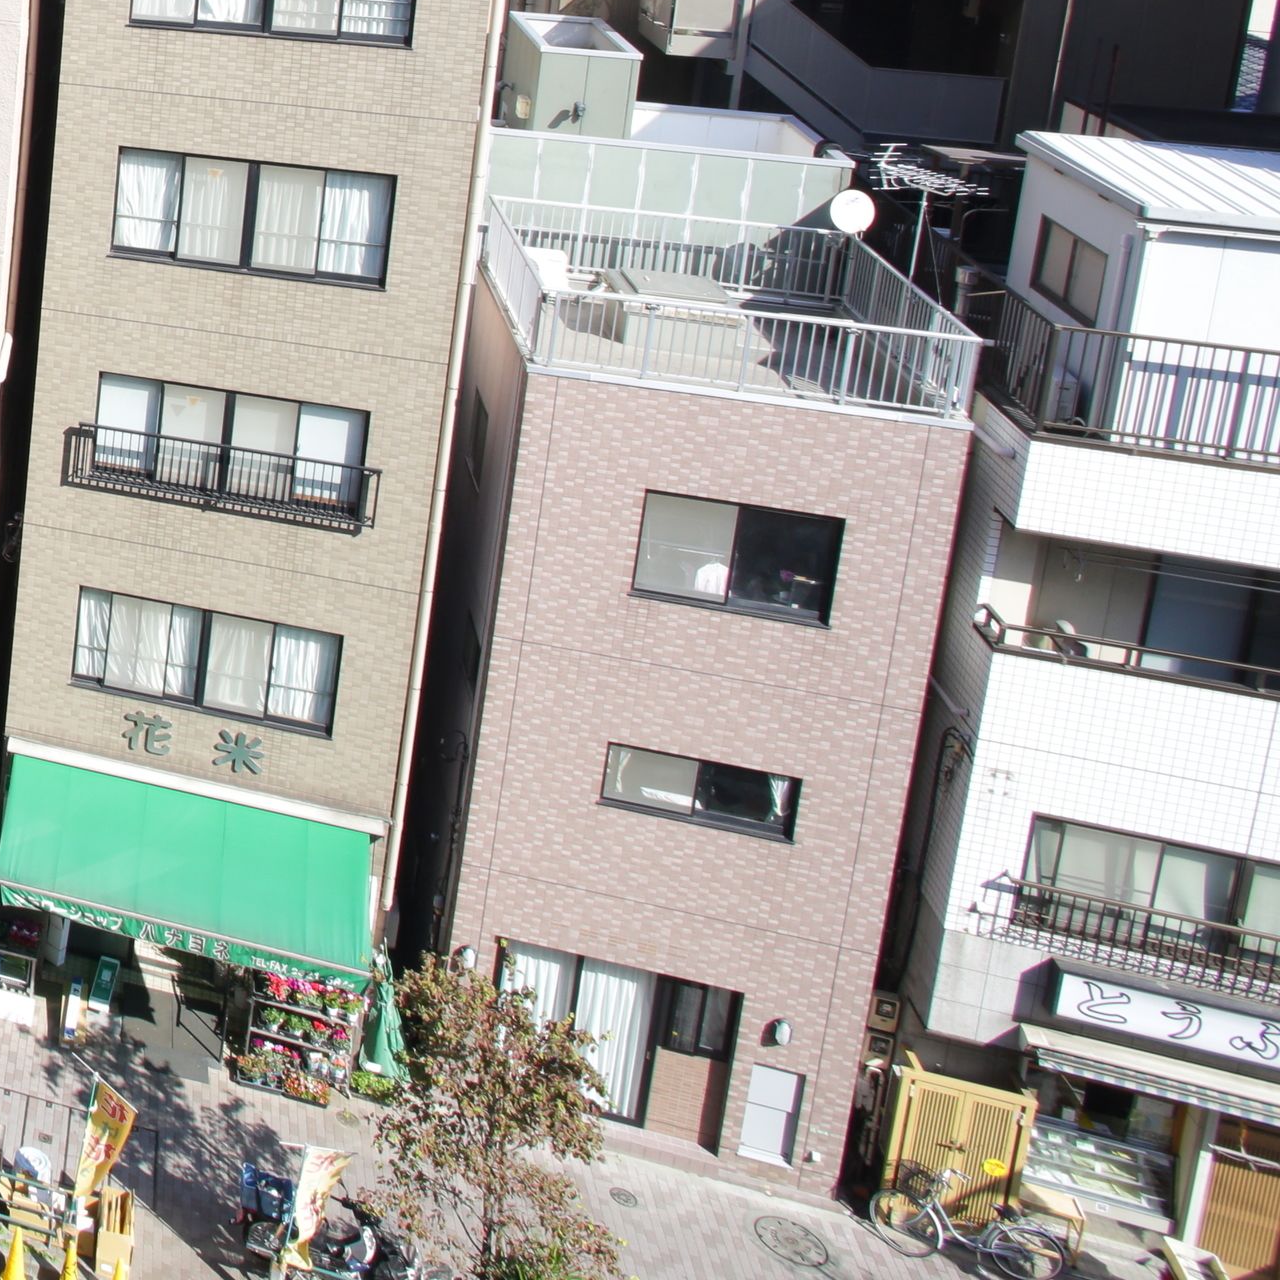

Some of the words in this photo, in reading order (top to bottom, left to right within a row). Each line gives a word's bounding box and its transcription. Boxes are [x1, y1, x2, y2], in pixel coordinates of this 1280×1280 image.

[122, 710, 265, 775] 花米
[140, 922, 230, 961] ハナヨネ
[1077, 980, 1280, 1060] とうふ
